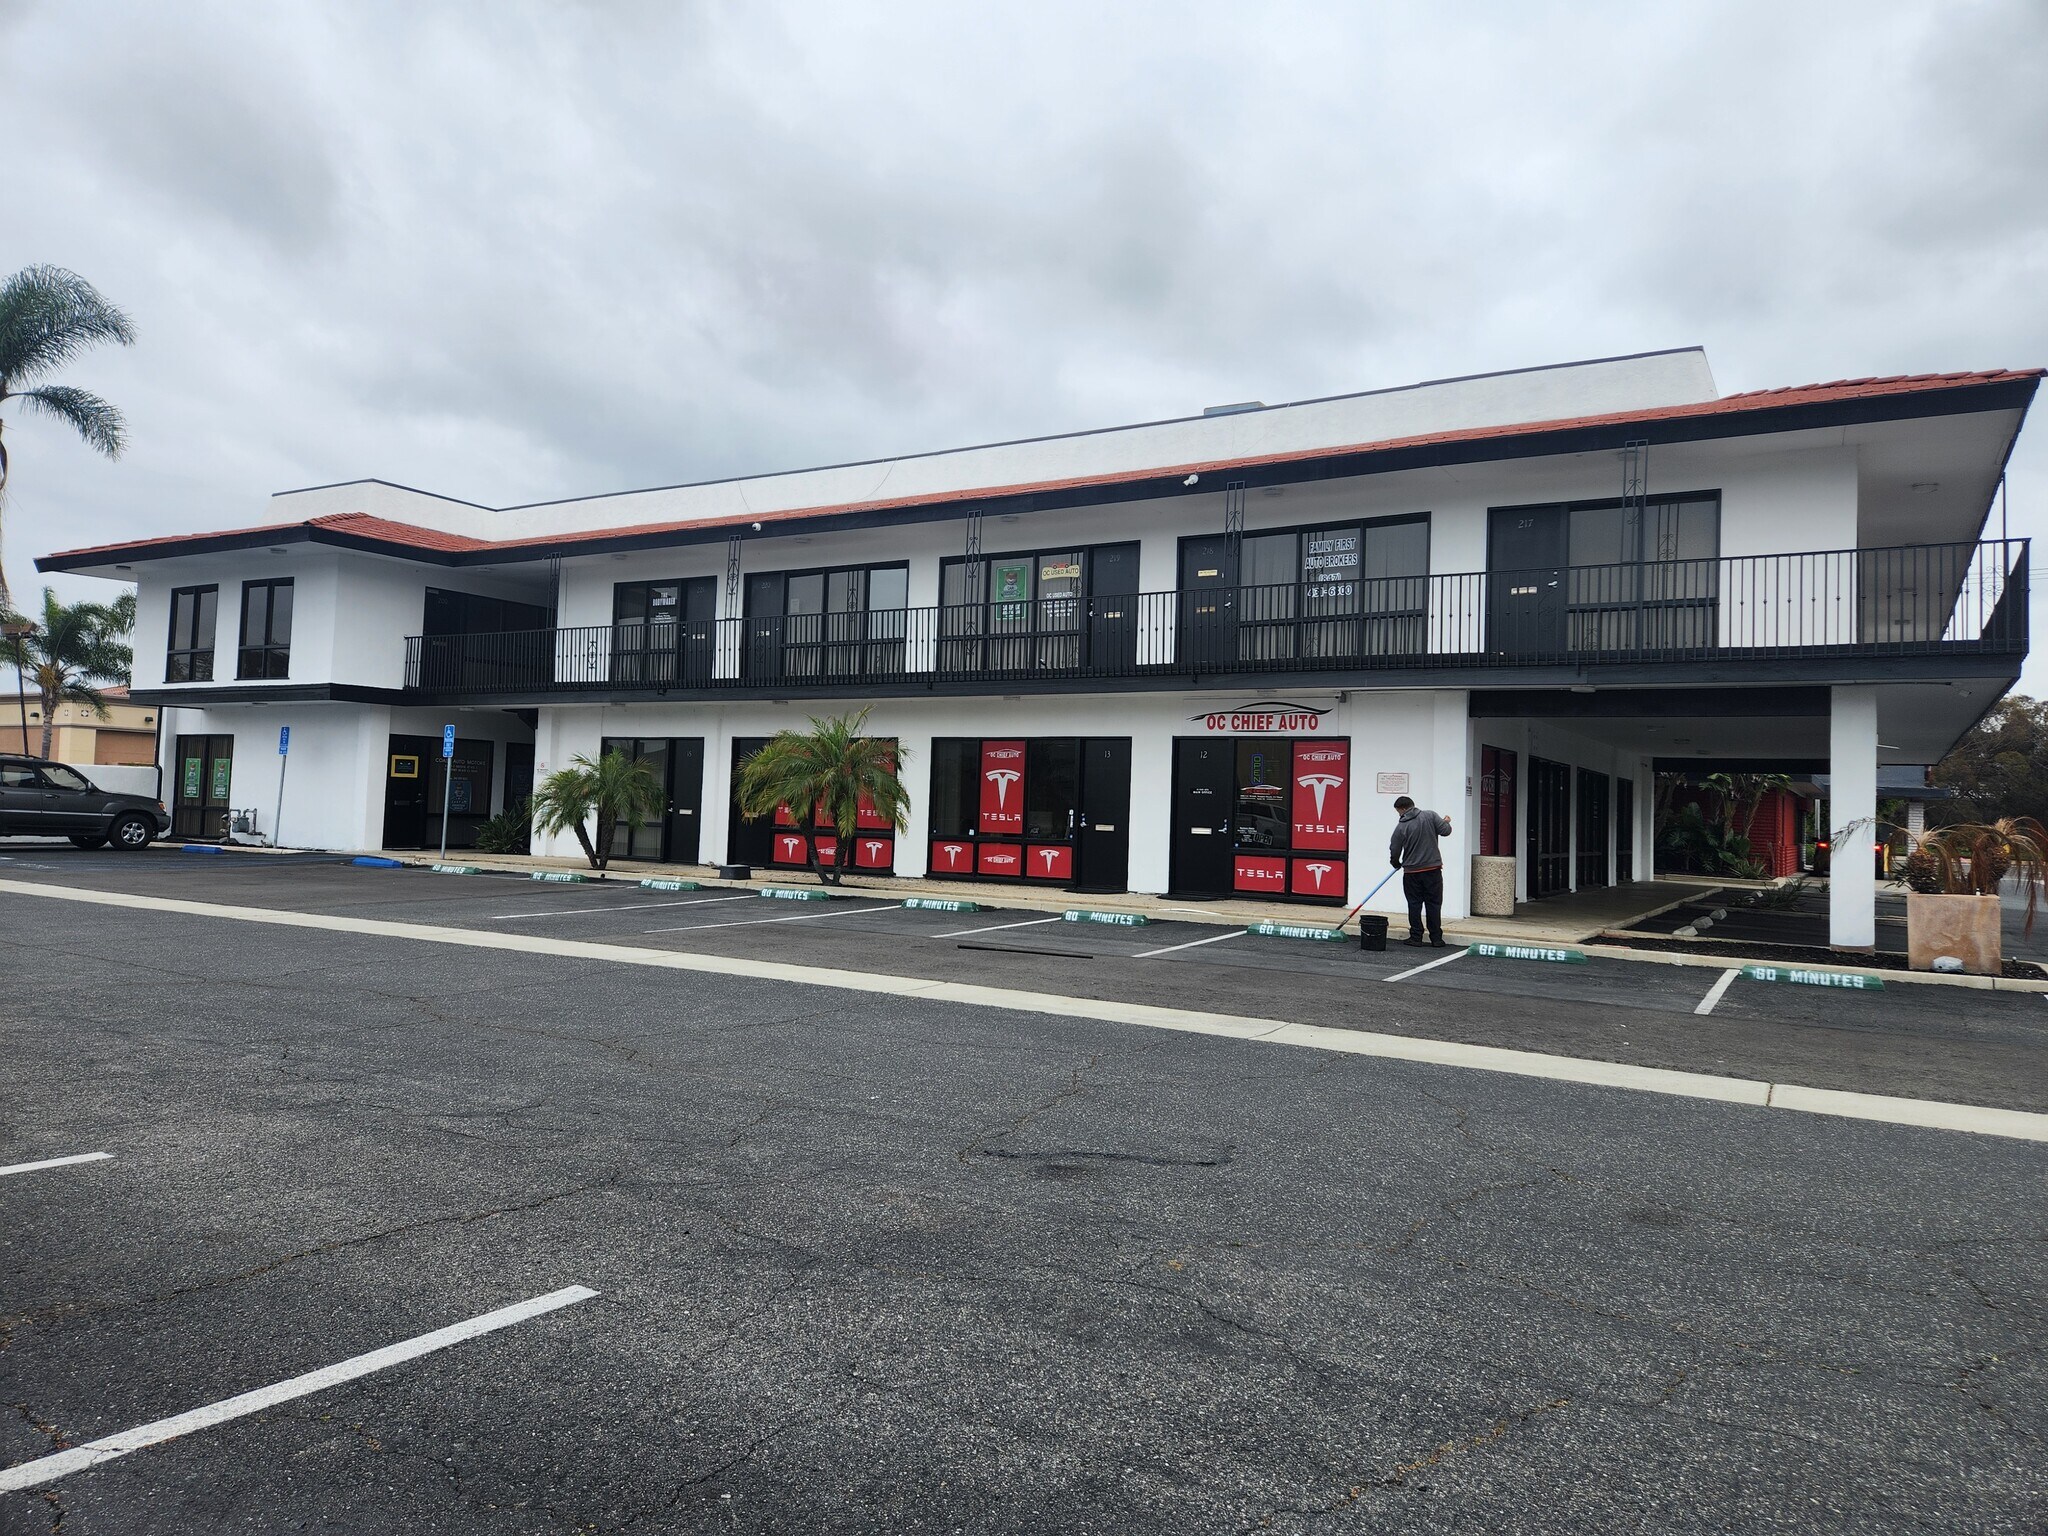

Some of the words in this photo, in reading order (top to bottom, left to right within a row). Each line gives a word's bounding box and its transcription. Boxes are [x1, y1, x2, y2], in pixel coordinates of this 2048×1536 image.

[1518, 519, 1534, 528] 217
[1309, 540, 1334, 553] FAMILY
[1335, 538, 1356, 551] FIRST
[1305, 556, 1323, 569] AUTO
[1325, 553, 1357, 567] BROKERS
[1207, 715, 1226, 730] OC
[1231, 715, 1273, 730] CHIEF
[1278, 714, 1318, 730] AUTO
[1104, 750, 1111, 758] 13
[983, 813, 1020, 821] TESLA
[1295, 824, 1344, 833] TESLA
[441, 866, 465, 874] MINUTES
[1237, 869, 1283, 878] TESLA
[544, 873, 571, 882] MINUTES
[651, 881, 680, 891] MINUTES
[775, 890, 809, 900] MINUTES
[921, 900, 960, 911] MINUTES
[1090, 912, 1133, 925] MINUTES
[1259, 925, 1274, 934] 60
[1280, 926, 1330, 939] MINUTES
[1479, 944, 1496, 955] 60
[1505, 946, 1566, 960] MINUTES
[1790, 970, 1864, 988] MINUTES
